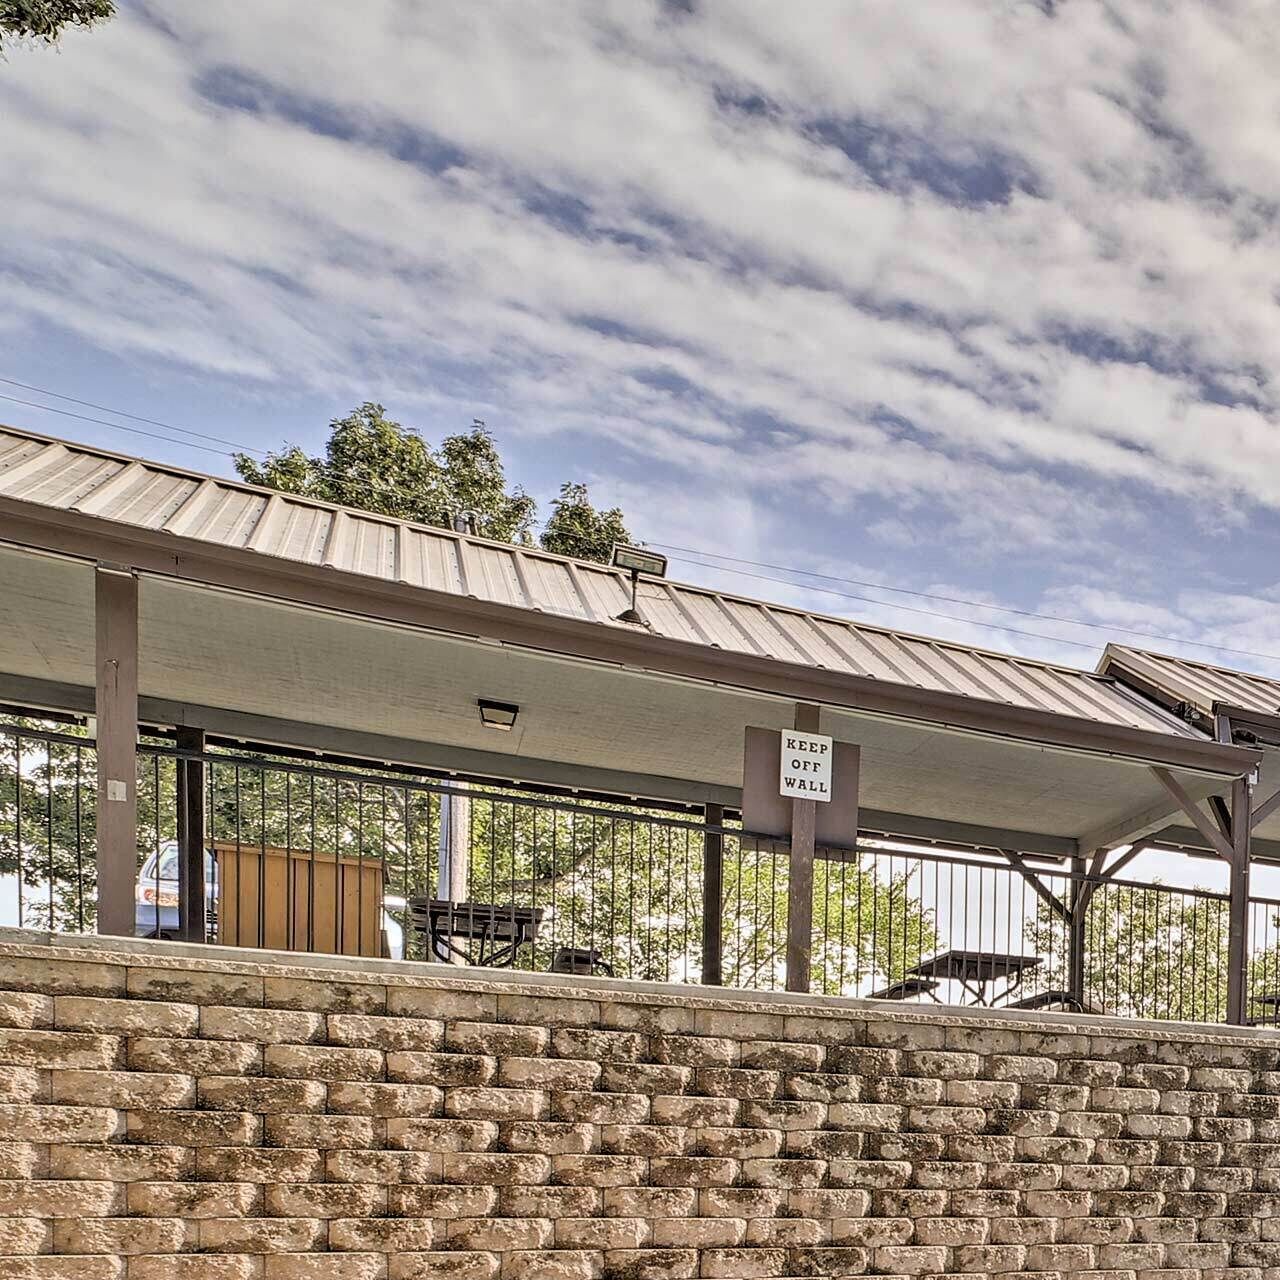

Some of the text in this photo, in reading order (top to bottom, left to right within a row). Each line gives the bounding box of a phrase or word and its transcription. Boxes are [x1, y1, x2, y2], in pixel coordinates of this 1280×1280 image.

[786, 738, 828, 755] KEEP
[791, 758, 822, 773] OFF
[784, 776, 828, 793] WALL
